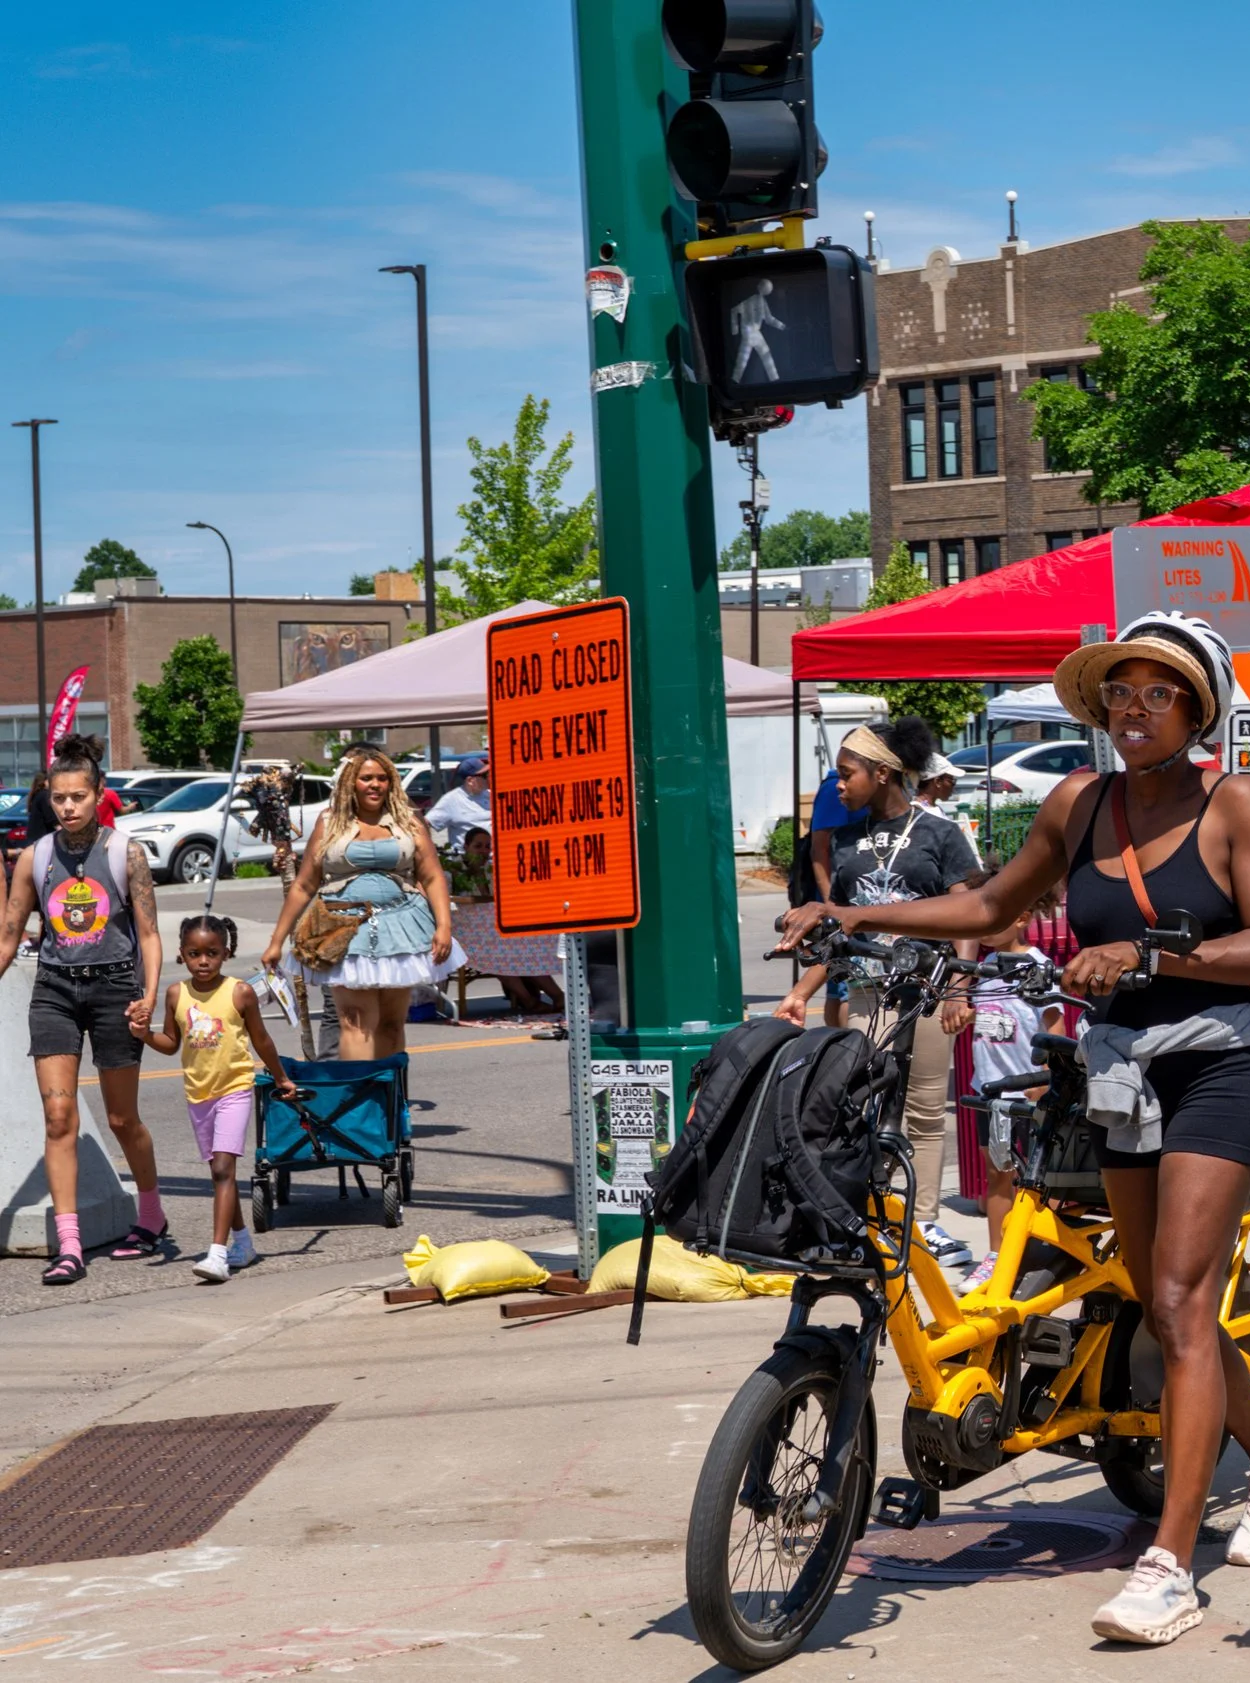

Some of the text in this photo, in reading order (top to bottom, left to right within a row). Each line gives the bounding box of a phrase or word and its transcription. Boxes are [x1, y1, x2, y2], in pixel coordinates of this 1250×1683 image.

[1161, 540, 1225, 557] WARNING
[1164, 569, 1202, 586] LITES
[495, 638, 621, 701] ROAD CLOSED
[509, 709, 608, 766] FOR EVENT
[497, 776, 624, 832] THURSDAY JUNE 19
[517, 842, 526, 883] 8
[529, 839, 551, 881] AM
[563, 836, 581, 878] 10
[584, 832, 606, 876] PM
[625, 1064, 670, 1075] PUMP
[610, 1087, 652, 1097] FABIOLA
